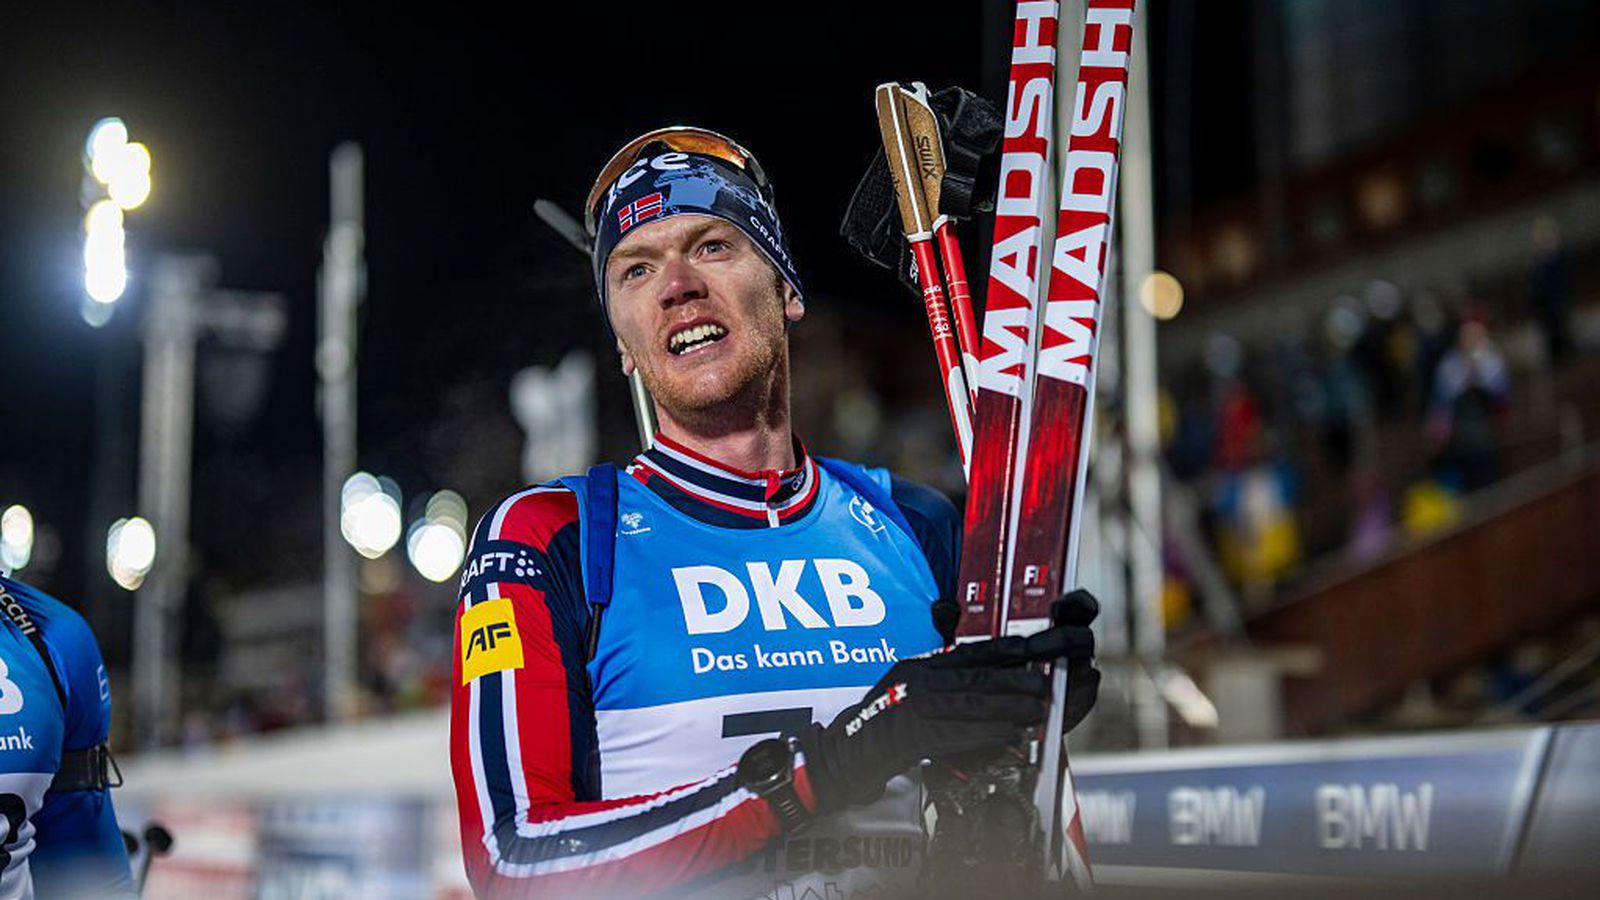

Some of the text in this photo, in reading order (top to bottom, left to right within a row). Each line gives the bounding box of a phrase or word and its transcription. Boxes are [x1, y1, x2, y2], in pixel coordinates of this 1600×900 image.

[671, 558, 887, 635] DKB
[465, 621, 512, 661] AF
[691, 638, 900, 675] Das kann Bank
[1168, 785, 1266, 847] BMW
[1316, 782, 1435, 852] BMW
